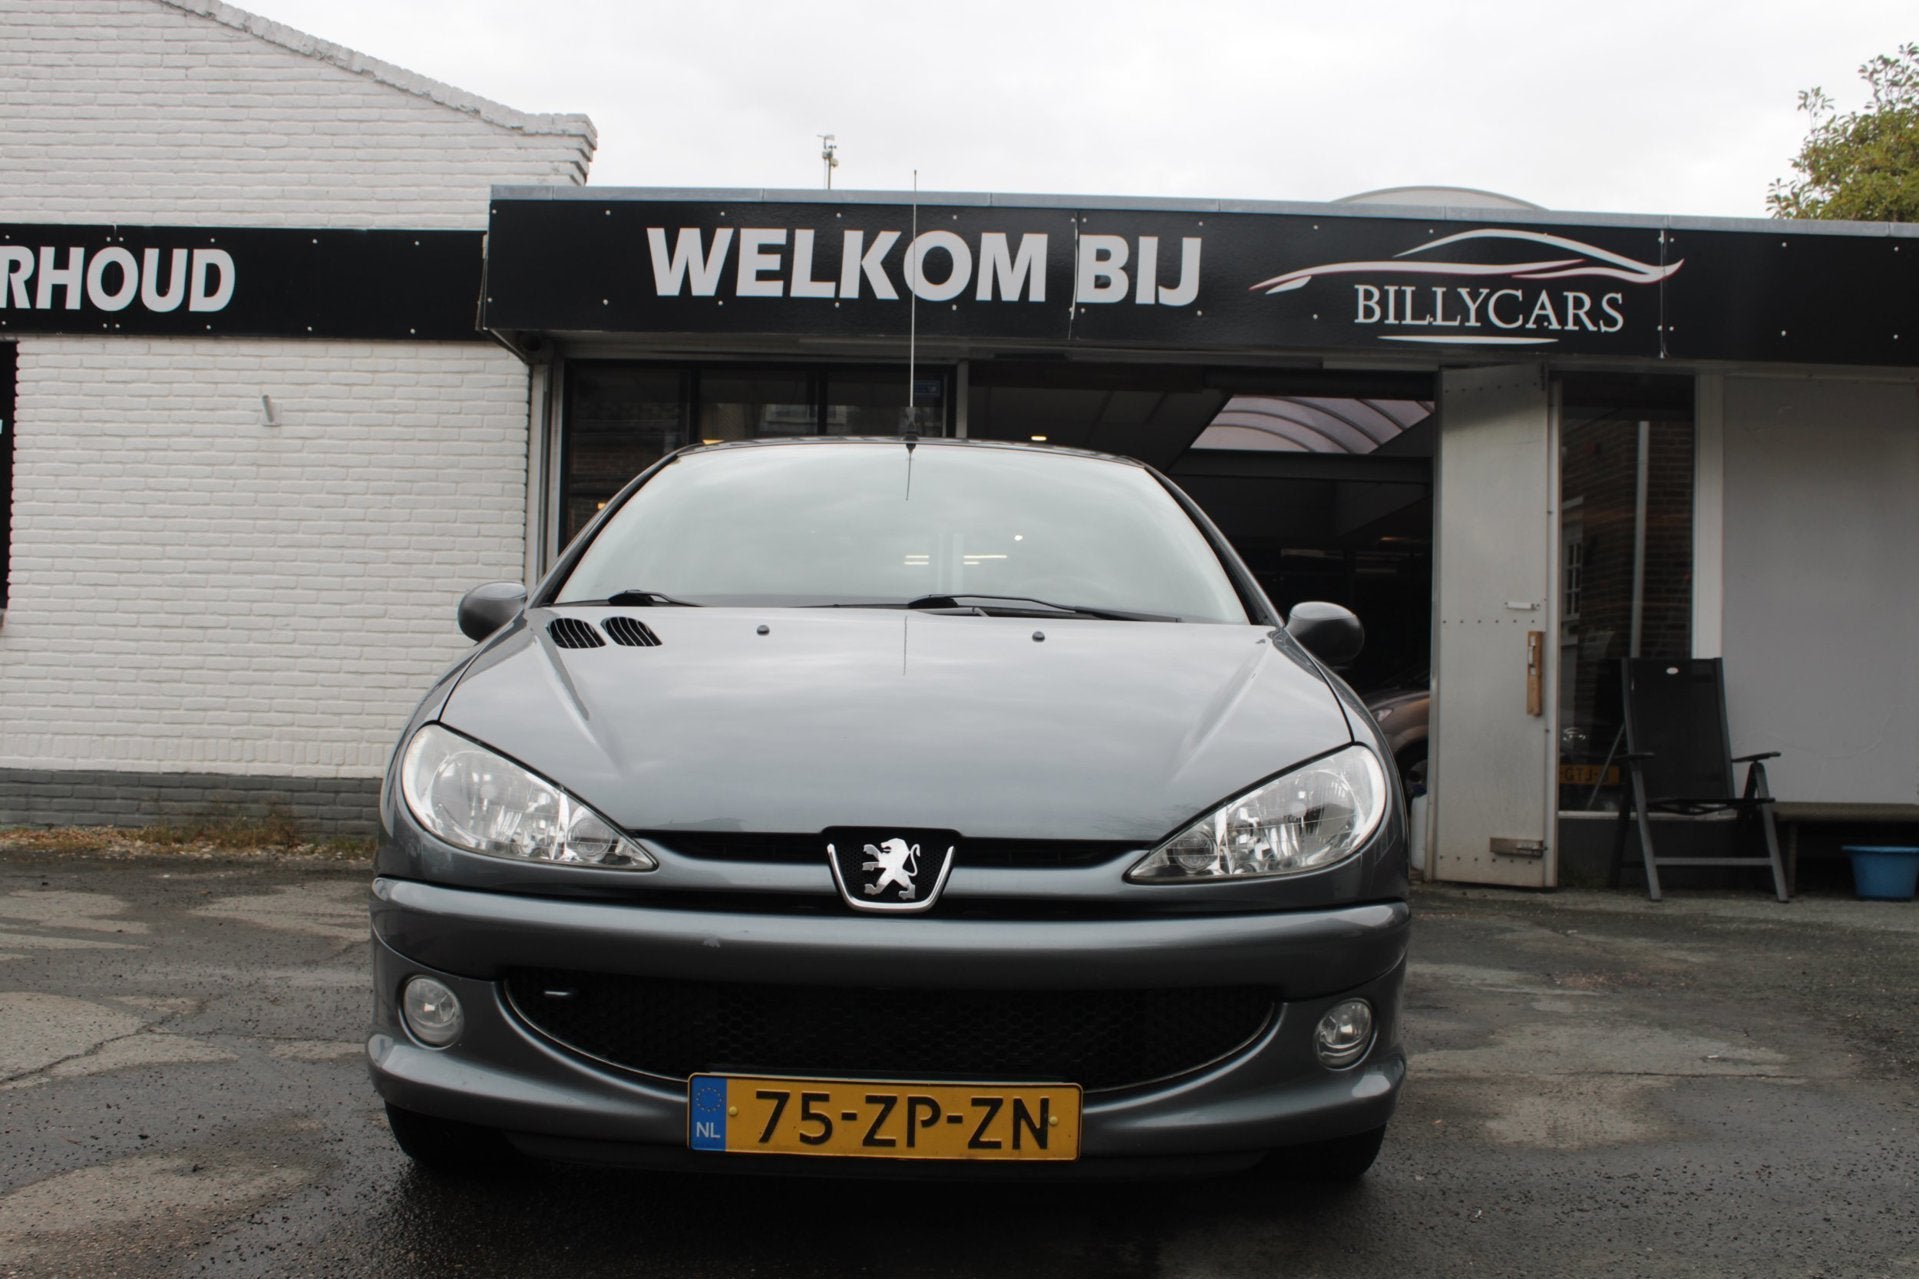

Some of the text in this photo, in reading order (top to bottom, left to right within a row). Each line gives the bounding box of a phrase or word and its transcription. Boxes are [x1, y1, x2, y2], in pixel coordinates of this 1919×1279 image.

[646, 227, 1202, 307] WELKOM BIJ
[1353, 284, 1624, 333] BILLYCARS
[696, 1121, 721, 1139] NL
[755, 1090, 1050, 1151] 75-ZP-ZN
